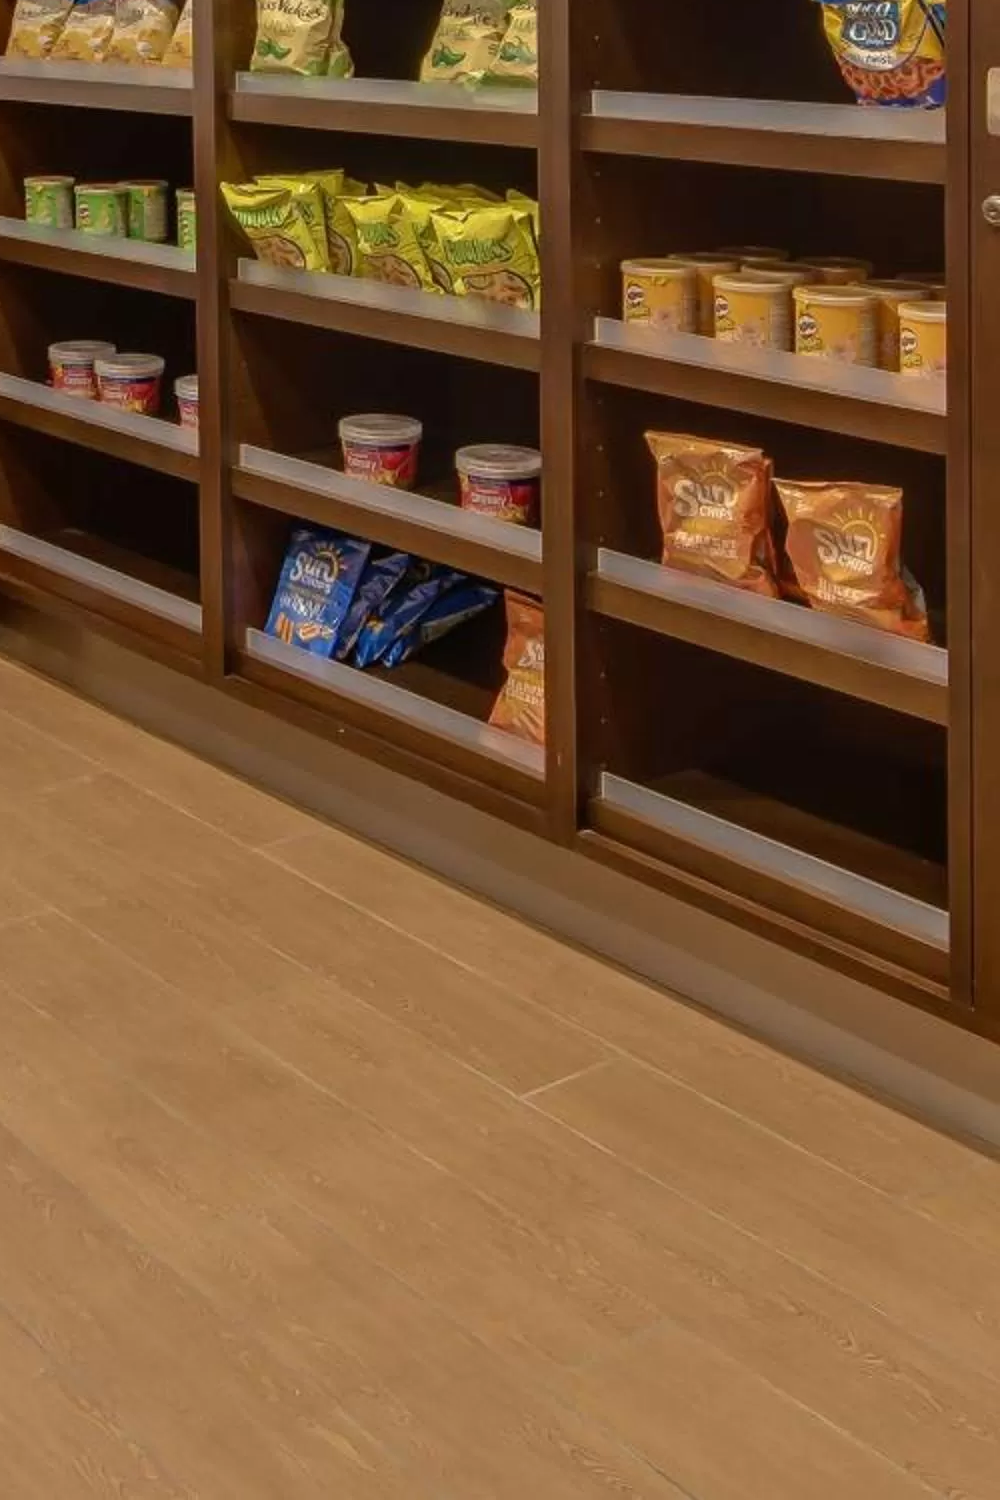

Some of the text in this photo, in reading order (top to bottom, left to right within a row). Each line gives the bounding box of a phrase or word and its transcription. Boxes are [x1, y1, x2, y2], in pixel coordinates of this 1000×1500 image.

[673, 478, 738, 518] Sun
[699, 505, 733, 521] CHIPS
[814, 526, 874, 564] Sun
[289, 552, 337, 583] Sun
[838, 555, 873, 576] CHIPS
